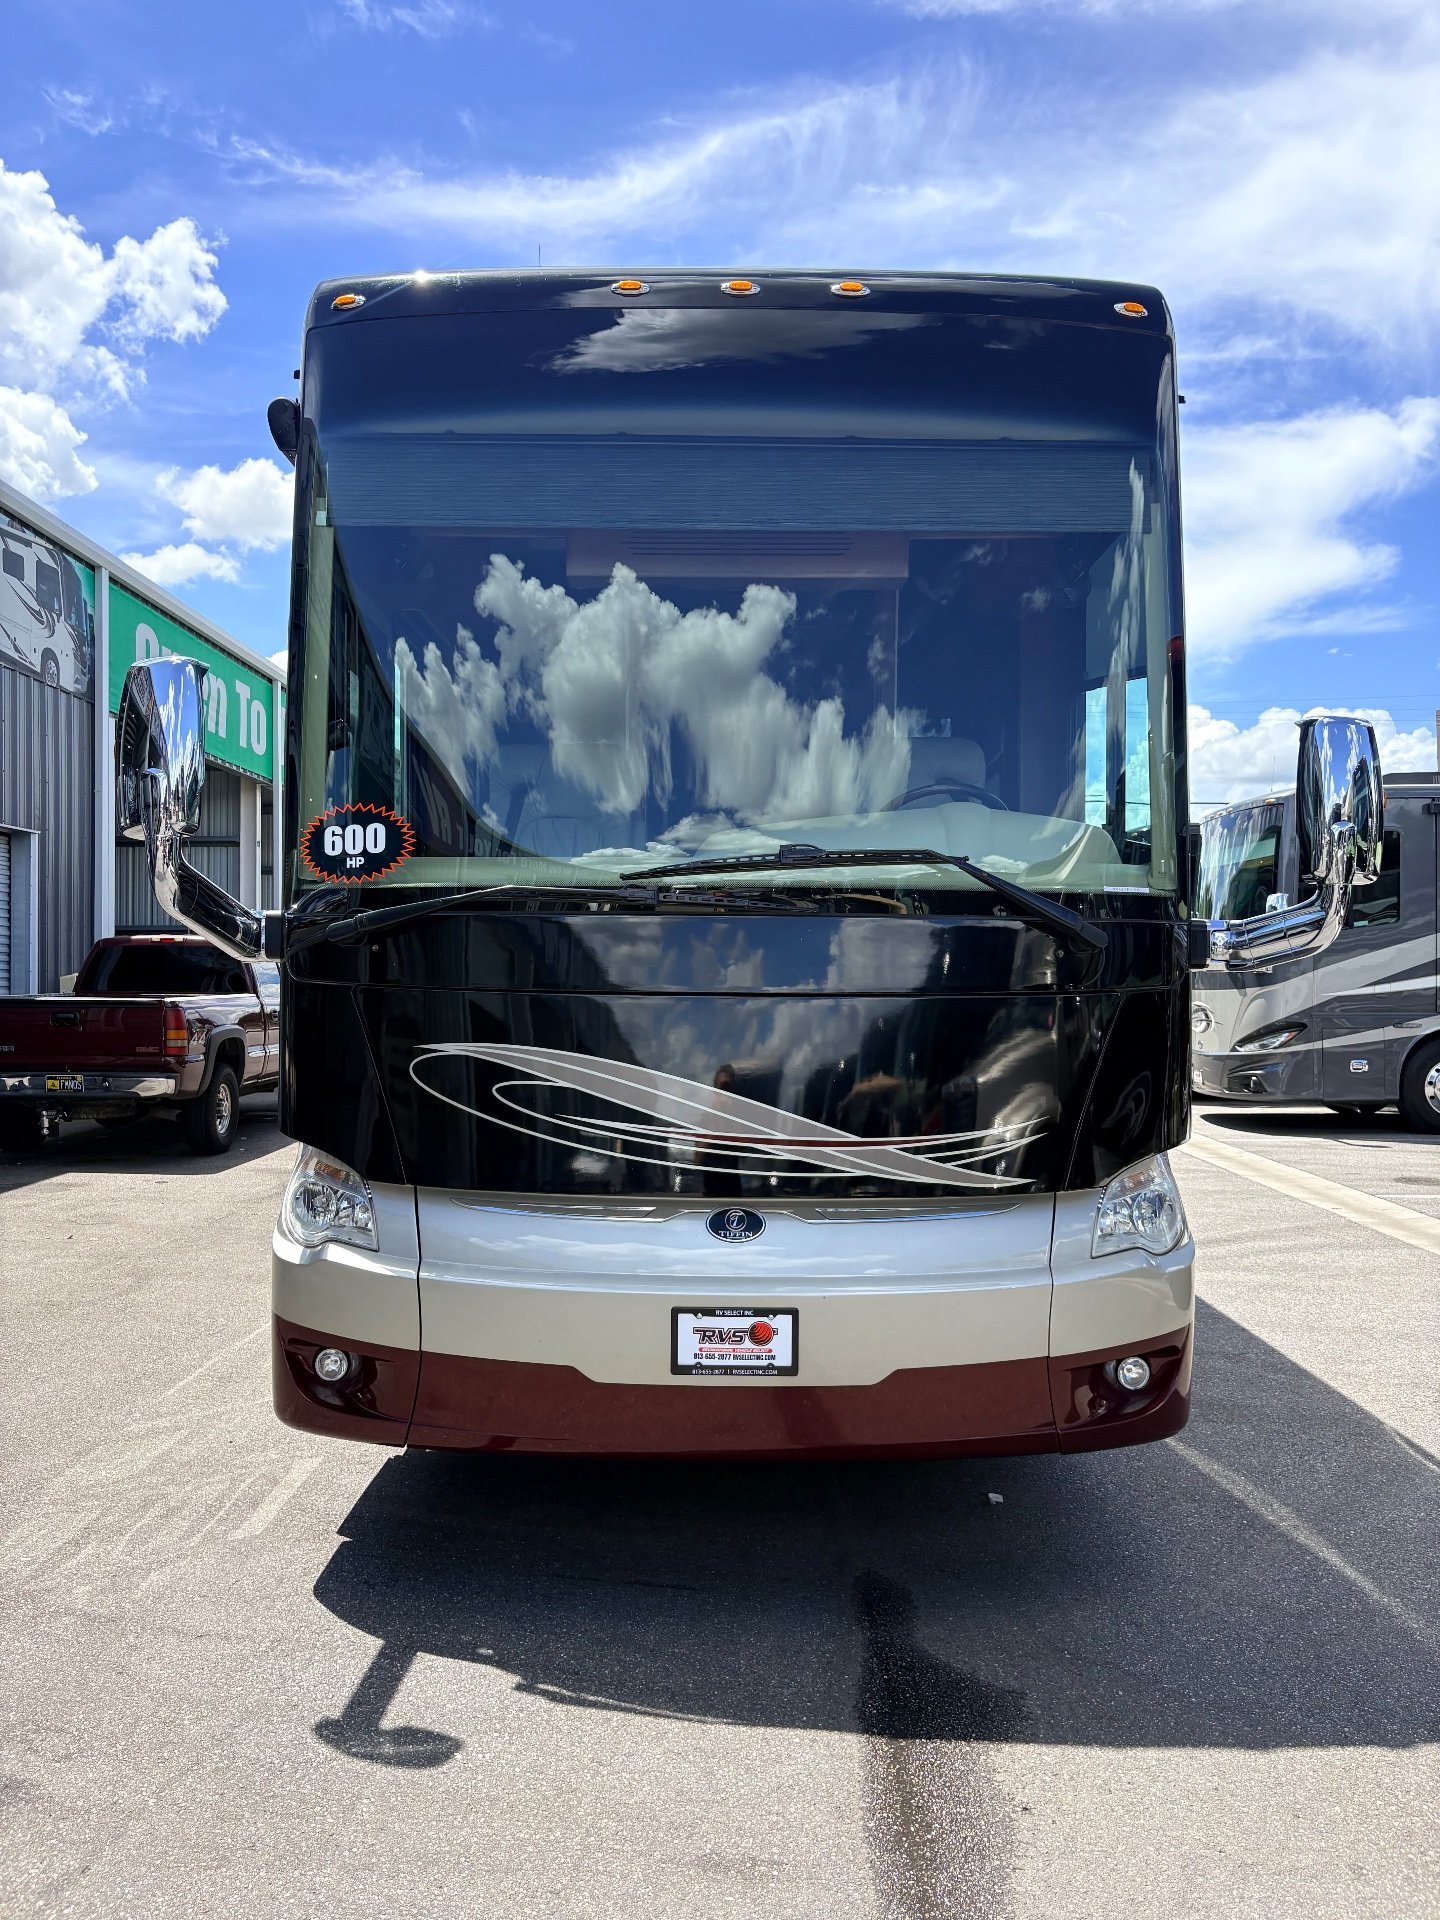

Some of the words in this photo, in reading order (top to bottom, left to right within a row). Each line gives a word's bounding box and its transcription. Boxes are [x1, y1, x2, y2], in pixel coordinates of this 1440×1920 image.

[235, 680, 267, 756] To
[324, 823, 386, 856] 600
[346, 857, 365, 868] HP
[693, 1327, 748, 1345] RVS
